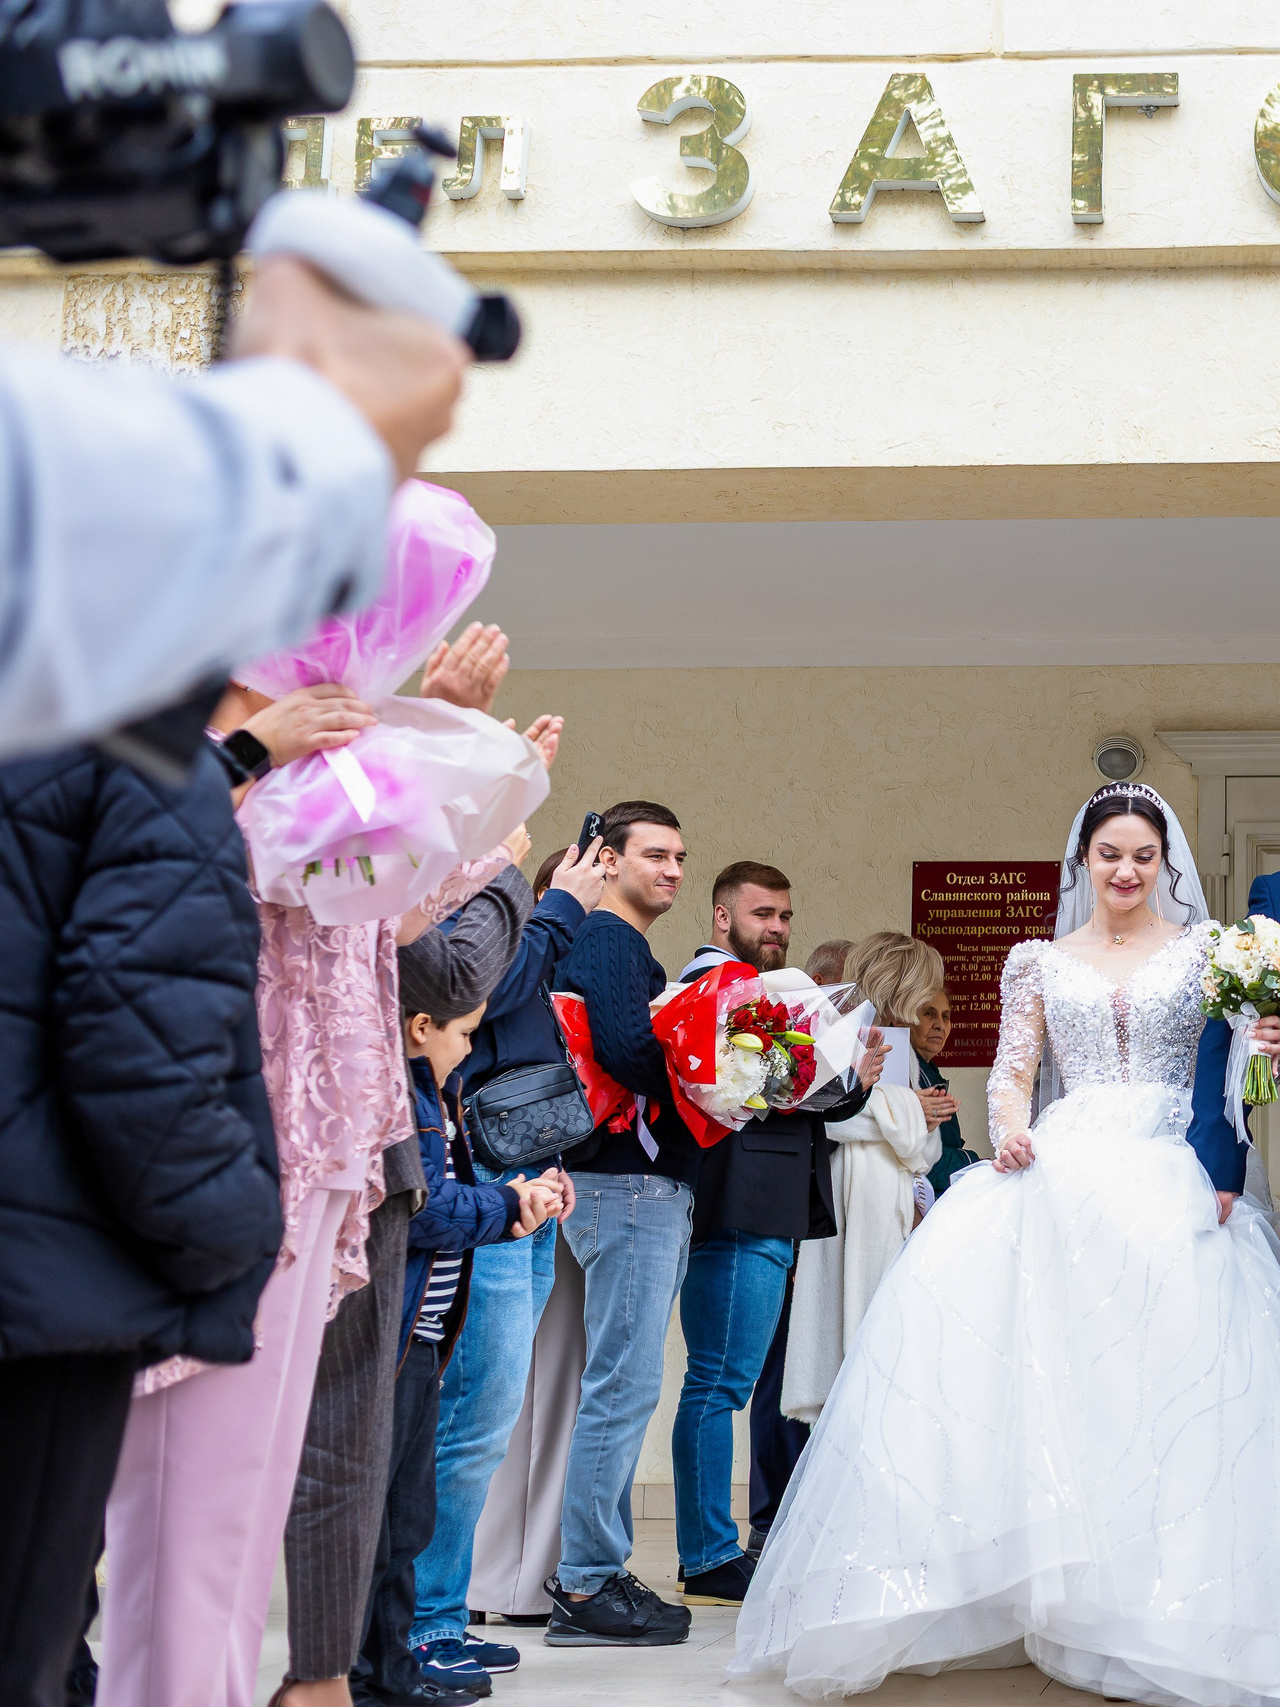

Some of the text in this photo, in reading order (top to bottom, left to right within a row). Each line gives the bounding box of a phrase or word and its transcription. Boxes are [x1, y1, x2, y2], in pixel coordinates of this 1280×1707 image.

[946, 872, 1026, 886] Отдел ЗАГС
[921, 889, 1051, 904] Славянского района
[927, 905, 1043, 921] управления ЗАГС
[916, 922, 1055, 937] Краснодарского края
[956, 943, 979, 952] Часы
[943, 955, 969, 963] орник,
[970, 973, 992, 981] 12.00
[980, 992, 997, 1000] 8.00
[970, 1002, 991, 1010] 12.00
[954, 1038, 998, 1047] ВЫХОДН
